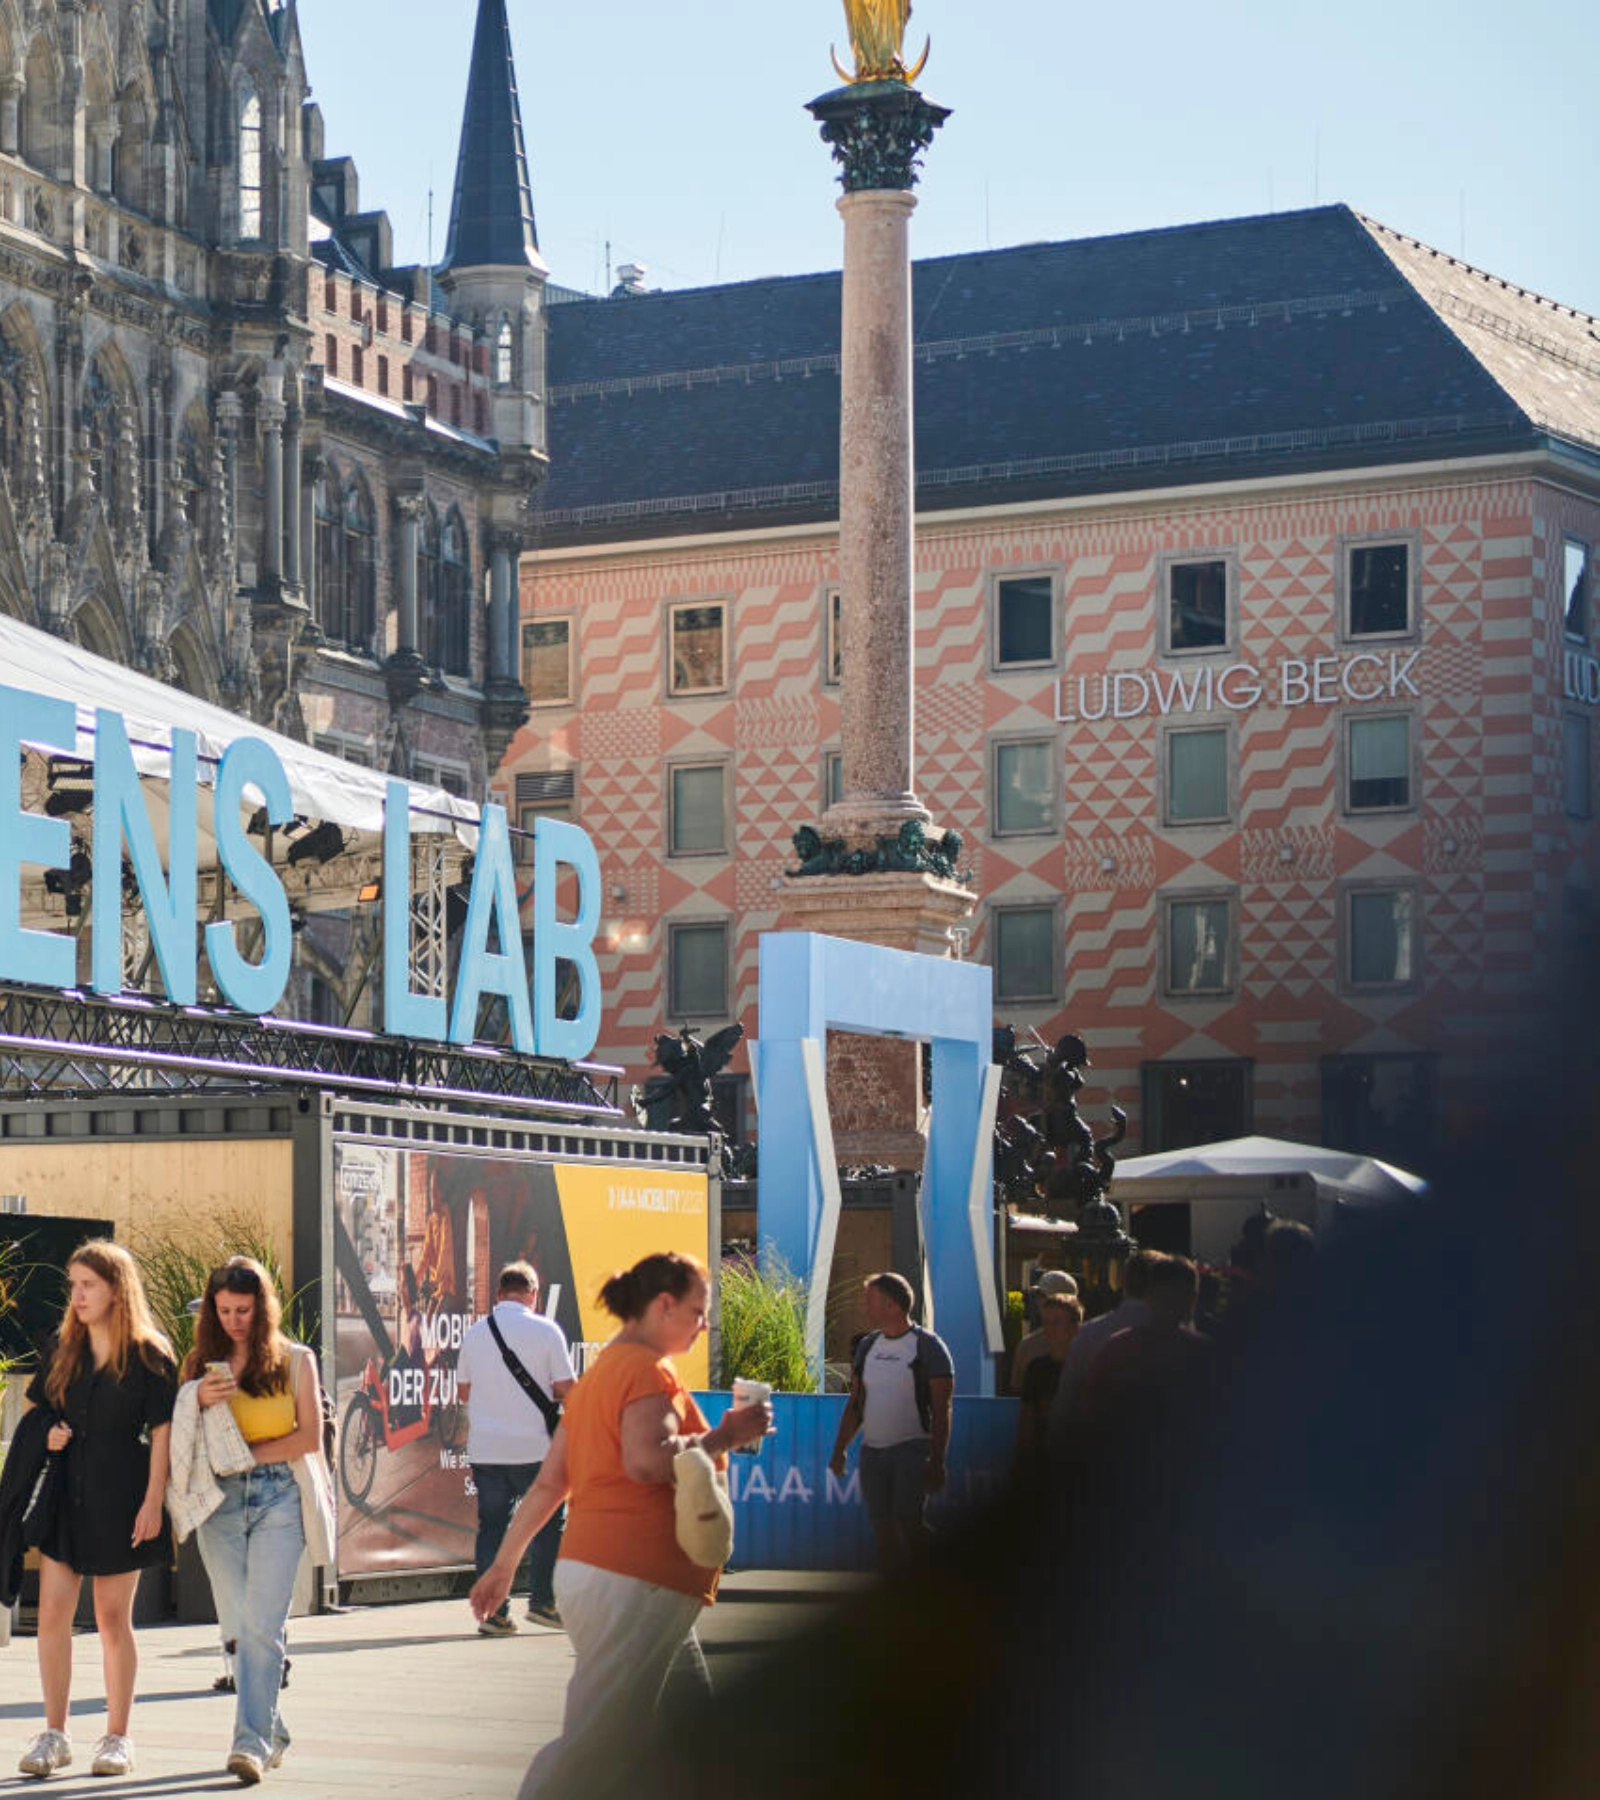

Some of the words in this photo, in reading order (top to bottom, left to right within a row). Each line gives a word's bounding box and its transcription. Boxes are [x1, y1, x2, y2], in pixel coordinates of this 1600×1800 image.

[1053, 664, 1262, 723] LUDWIG
[1281, 651, 1421, 706] BECK
[386, 781, 602, 1061] LAB
[389, 1369, 425, 1406] DER
[440, 1449, 456, 1469] Wie
[731, 1464, 813, 1503] IAA
